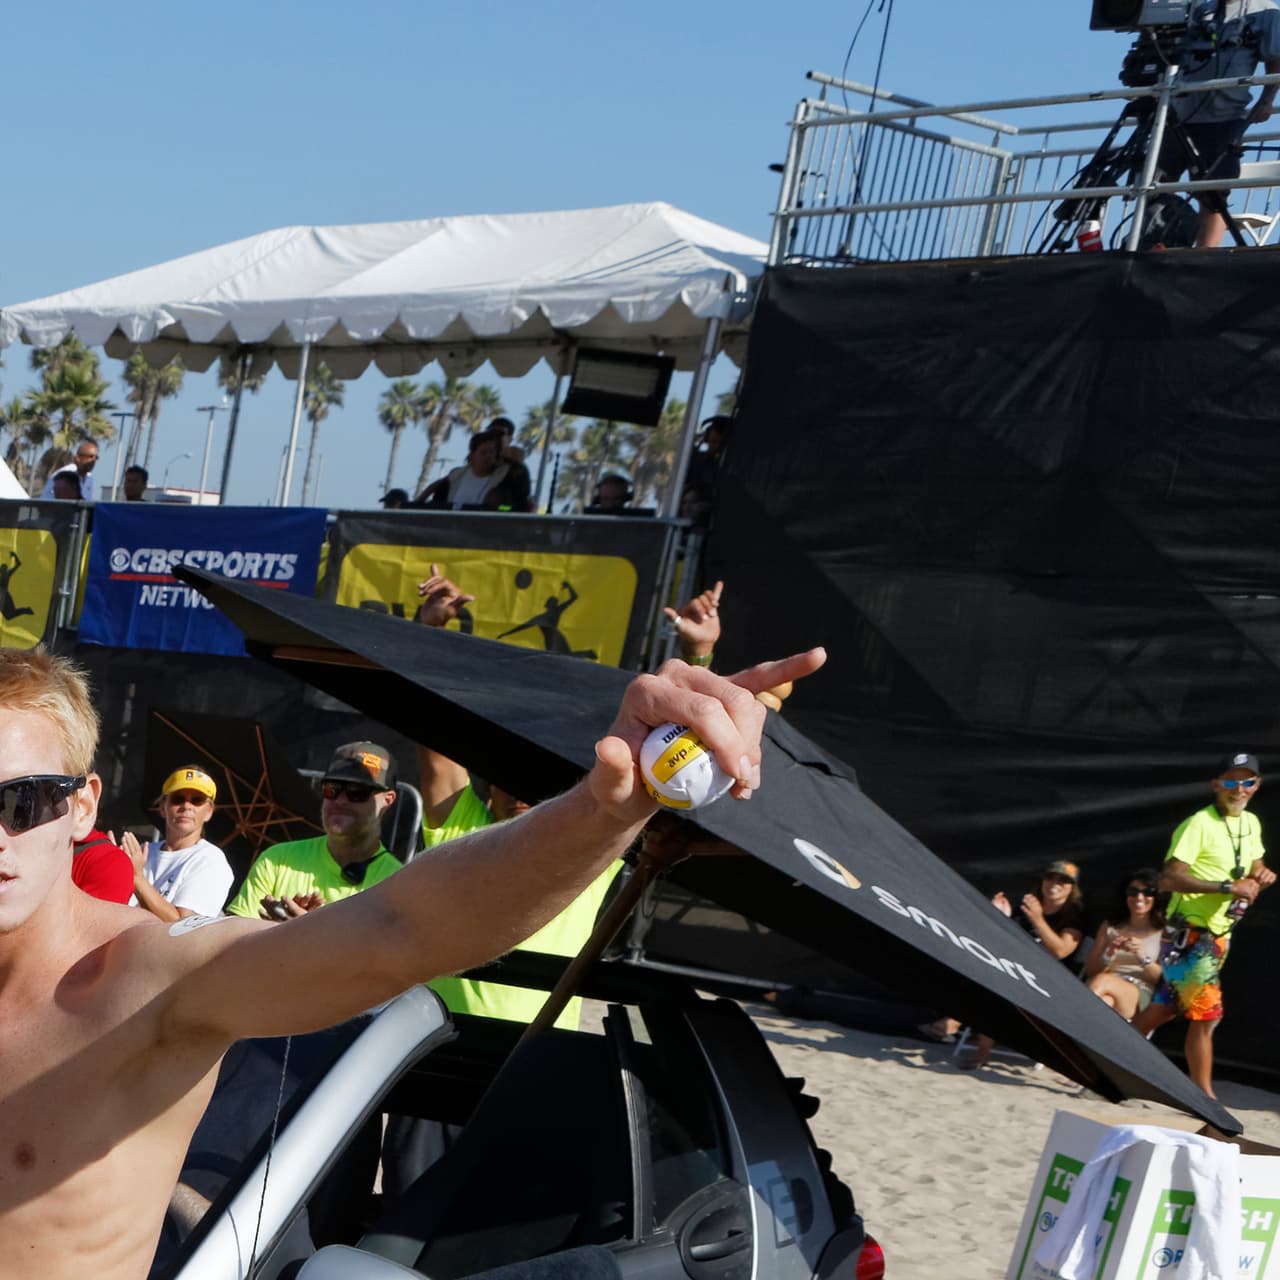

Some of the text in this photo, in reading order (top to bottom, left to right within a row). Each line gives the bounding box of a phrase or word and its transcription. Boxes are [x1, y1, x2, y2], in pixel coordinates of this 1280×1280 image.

[140, 585, 215, 610] NETW
[871, 885, 1052, 998] smart
[1052, 1167, 1122, 1213] TRH
